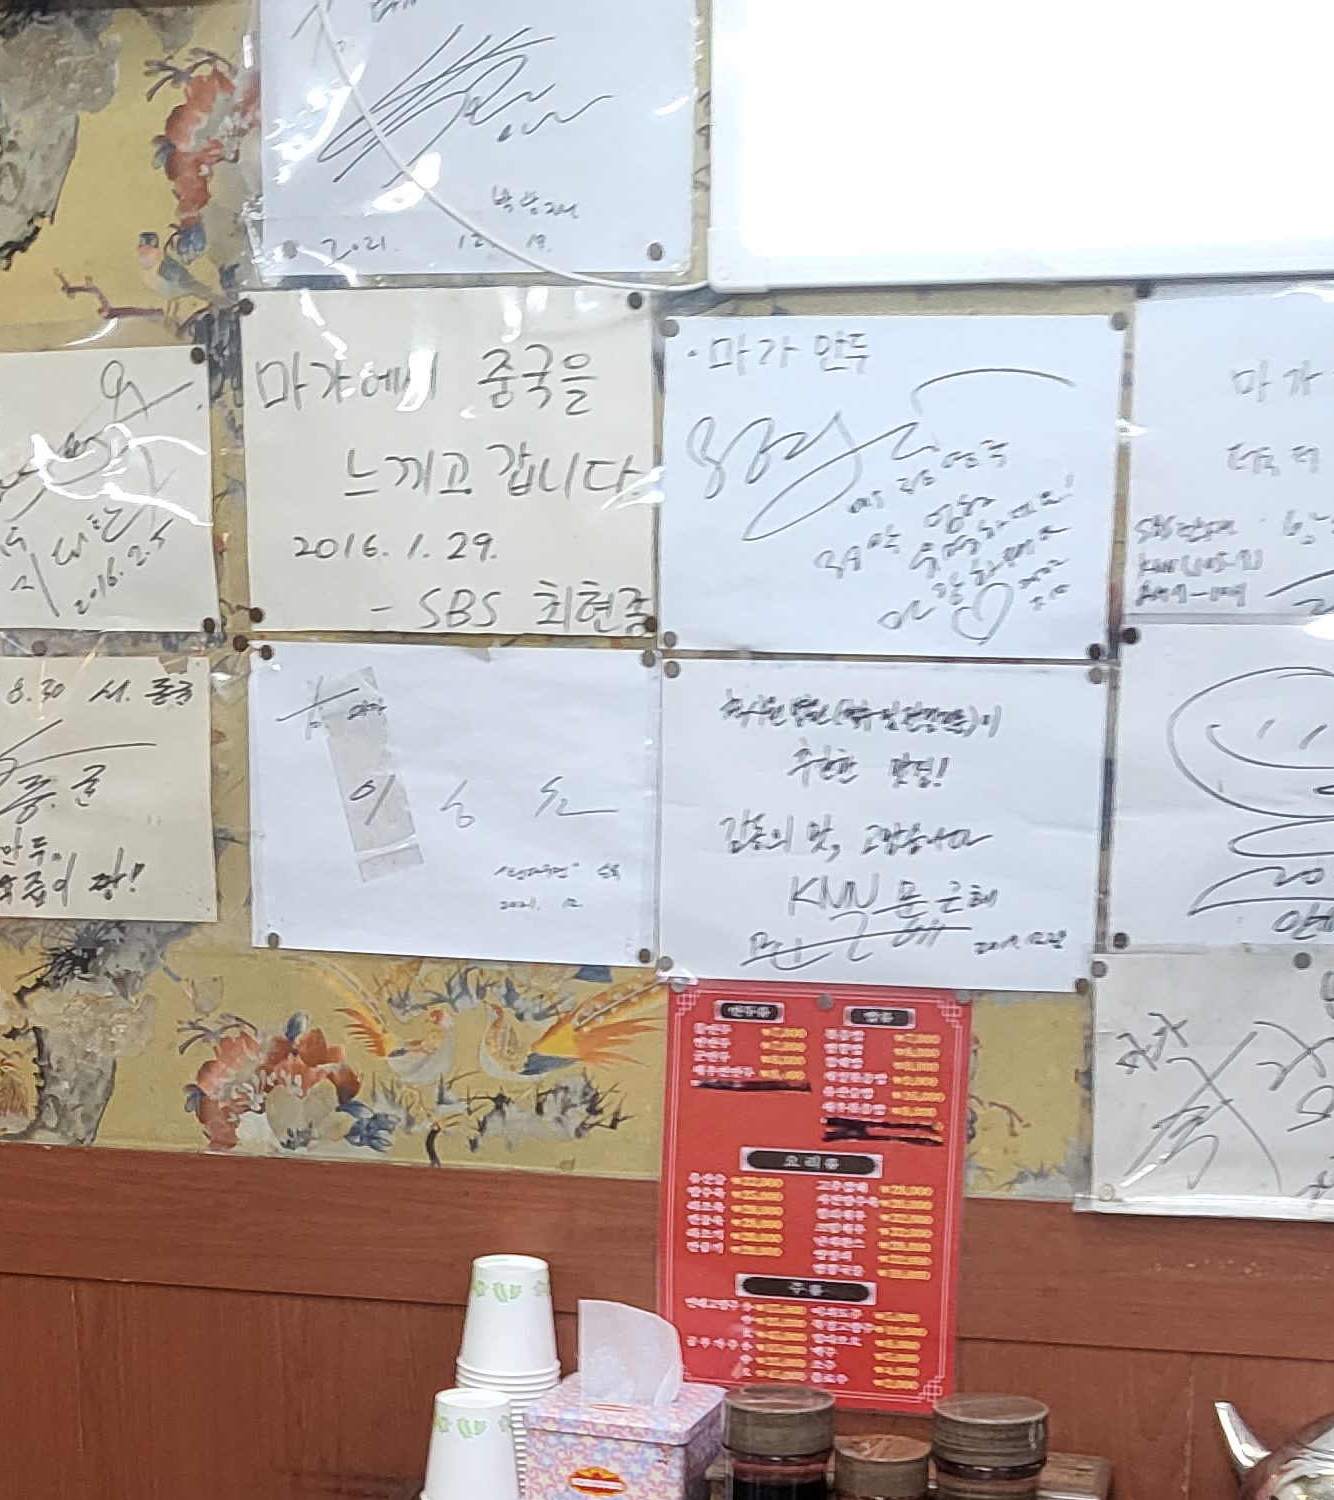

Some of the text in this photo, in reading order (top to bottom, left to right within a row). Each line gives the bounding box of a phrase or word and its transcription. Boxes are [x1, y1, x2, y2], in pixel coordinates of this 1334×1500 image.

[477, 343, 598, 417] 중국을
[343, 440, 645, 499] 느끼고 갑니다
[293, 530, 499, 563] 2016. 1. 29.
[419, 587, 502, 629] SBS
